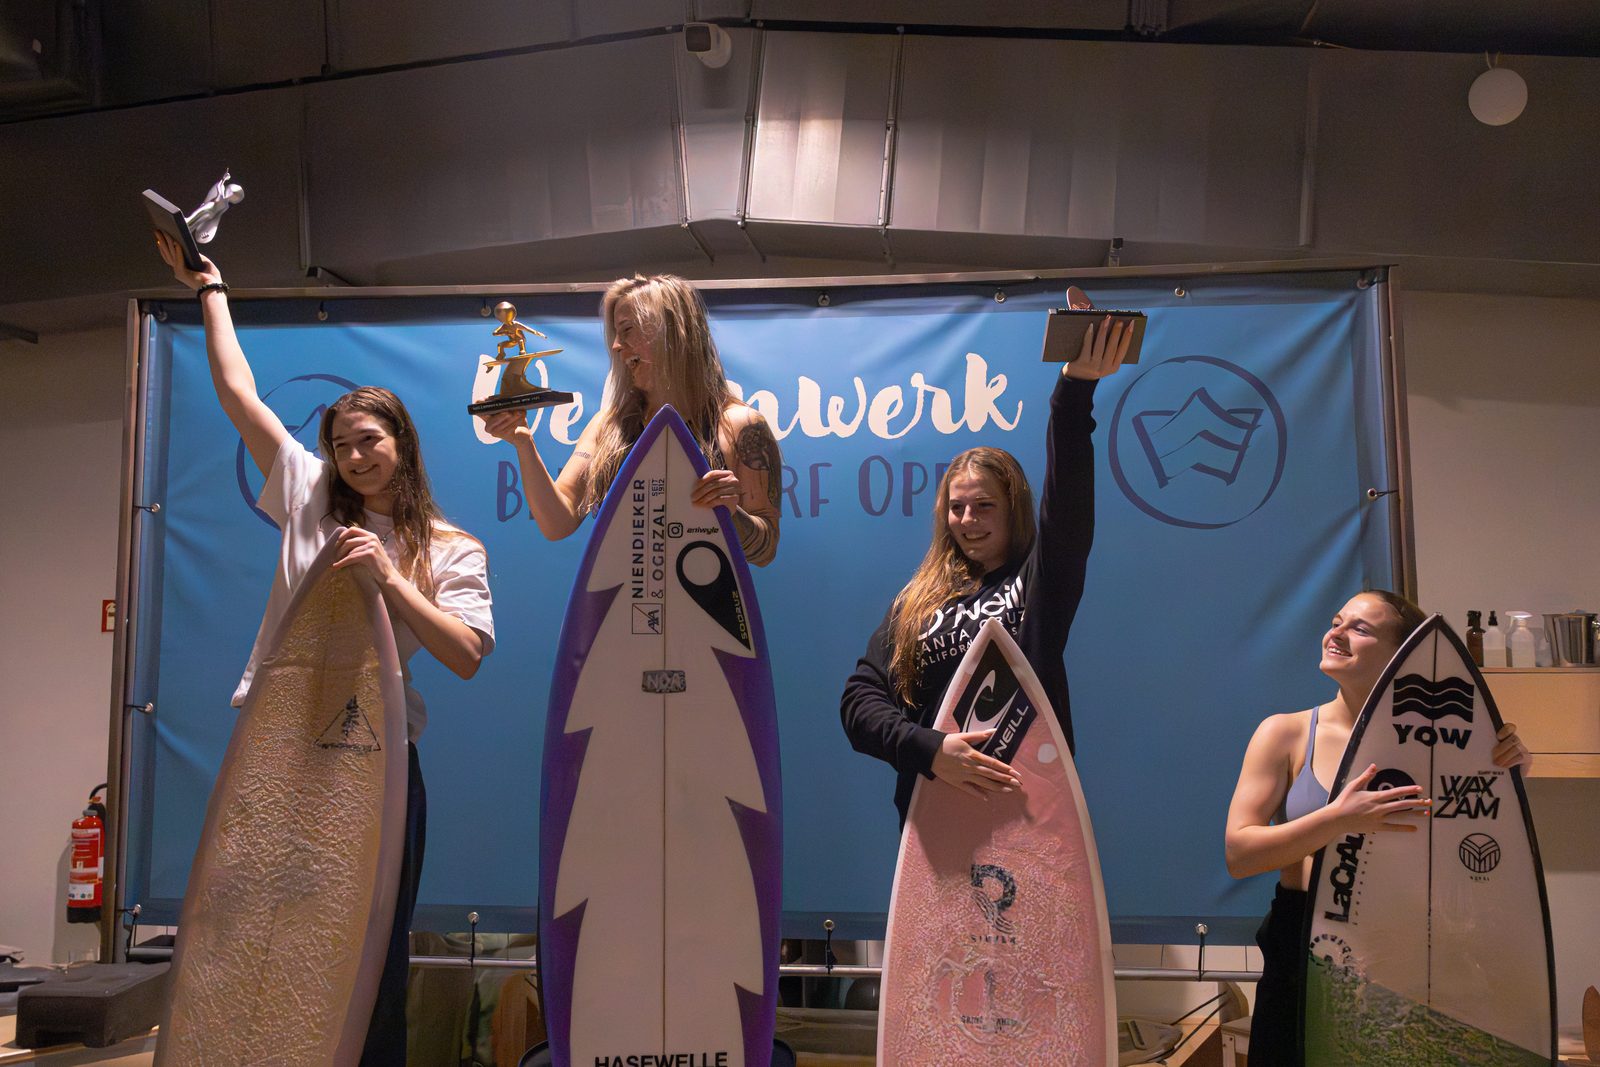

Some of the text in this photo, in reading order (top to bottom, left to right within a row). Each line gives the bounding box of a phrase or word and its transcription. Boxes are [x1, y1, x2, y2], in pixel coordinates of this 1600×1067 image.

[651, 479, 659, 496] SEIT
[632, 479, 645, 599] NIENDIEKER
[651, 504, 665, 599] & OGRZAL
[921, 628, 970, 656] ANTA
[992, 705, 1029, 759] 'NEILL
[1392, 723, 1473, 750] YOW
[1440, 775, 1498, 798] WAX
[1433, 796, 1500, 820] ZAM
